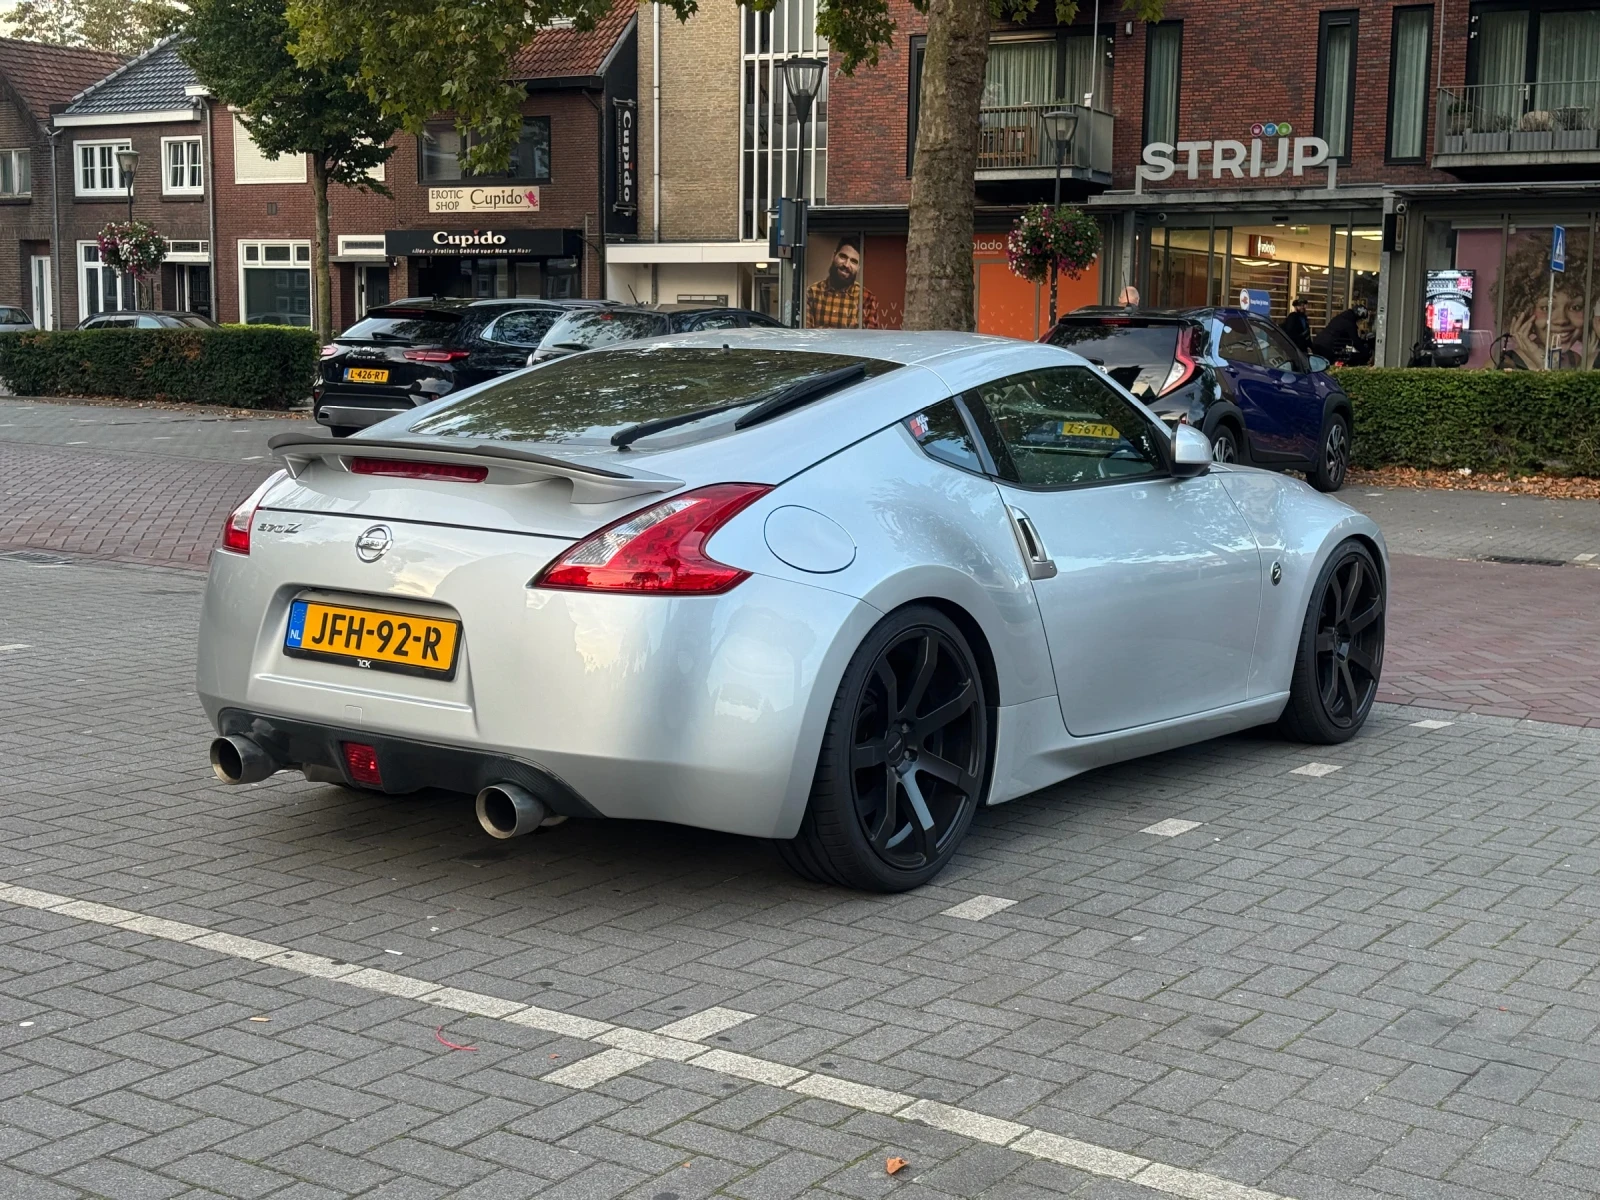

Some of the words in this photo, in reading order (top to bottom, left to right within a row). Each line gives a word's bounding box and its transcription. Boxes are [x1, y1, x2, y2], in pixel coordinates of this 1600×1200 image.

[622, 111, 633, 202] Cupido
[1142, 136, 1329, 181] STRIJP
[431, 189, 464, 199] EROTIC
[470, 188, 523, 209] Cupido
[435, 201, 460, 210] SHOP
[433, 229, 506, 247] Cupido
[350, 370, 386, 381] L-426-RT
[1067, 423, 1114, 437] Z-767-KJ
[290, 629, 301, 640] NL
[311, 612, 442, 662] JFH-92-R
